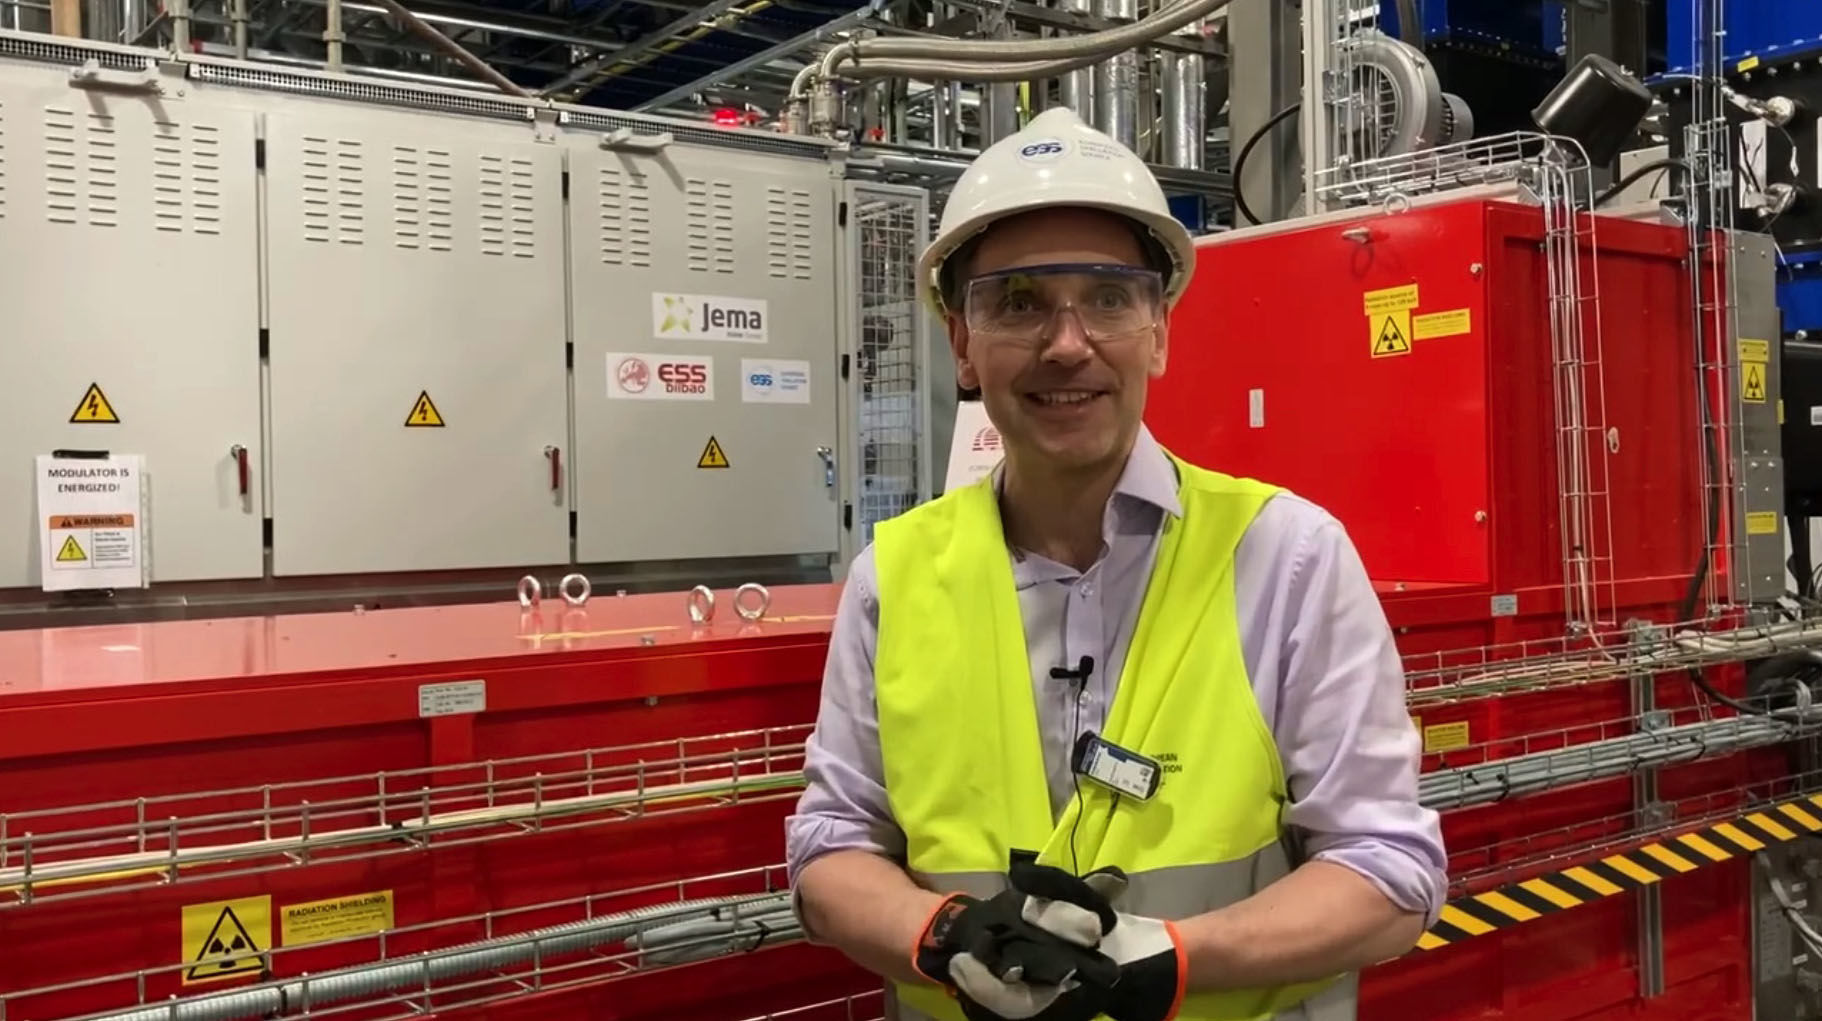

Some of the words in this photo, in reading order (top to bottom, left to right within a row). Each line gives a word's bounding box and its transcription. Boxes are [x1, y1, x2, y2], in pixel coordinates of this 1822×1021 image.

[701, 302, 762, 333] Jema
[666, 382, 705, 393] bilbao
[48, 468, 118, 478] MODULATOR
[120, 468, 129, 477] IS
[58, 483, 120, 493] ENERGIZED!
[74, 516, 124, 525] WARNING
[289, 904, 338, 917] RADIATION
[340, 896, 386, 910] SHIELDING
